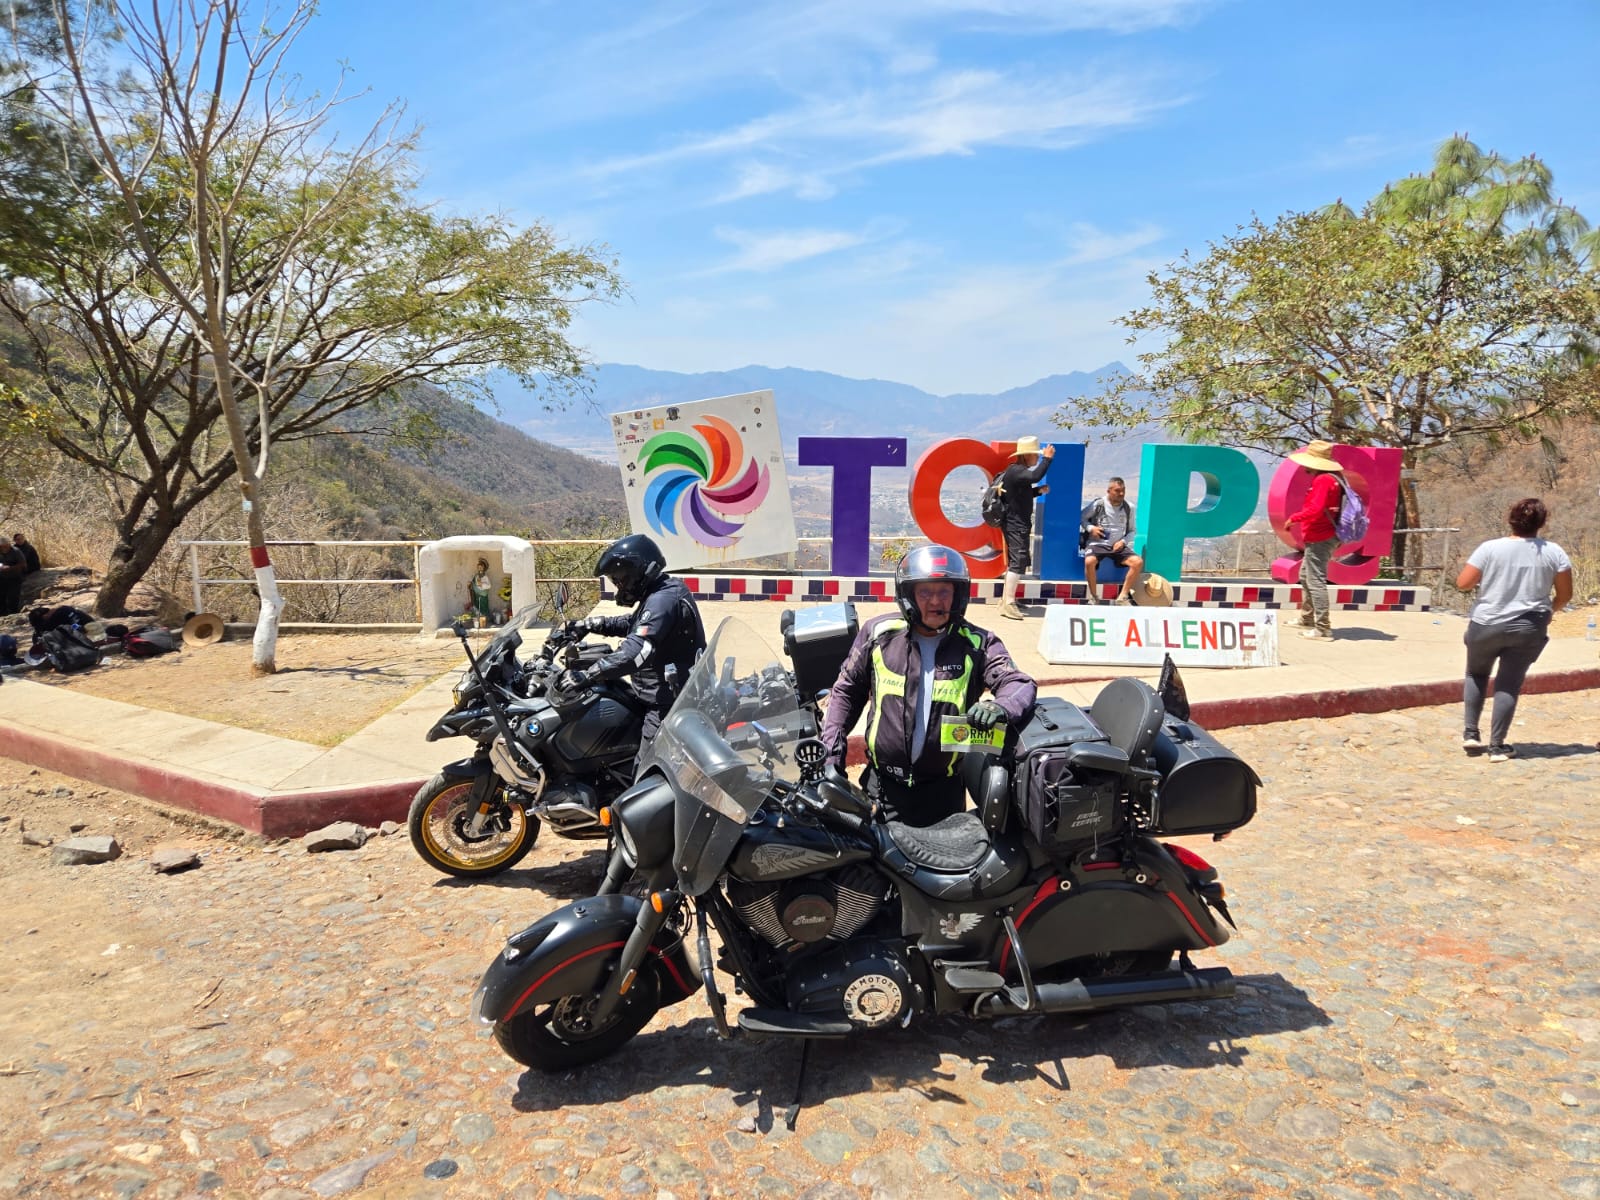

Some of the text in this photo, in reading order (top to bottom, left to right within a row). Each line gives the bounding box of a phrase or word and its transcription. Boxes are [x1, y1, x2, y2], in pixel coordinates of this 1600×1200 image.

[1069, 617, 1257, 651] DE ALLENDE
[970, 728, 994, 740] RRM
